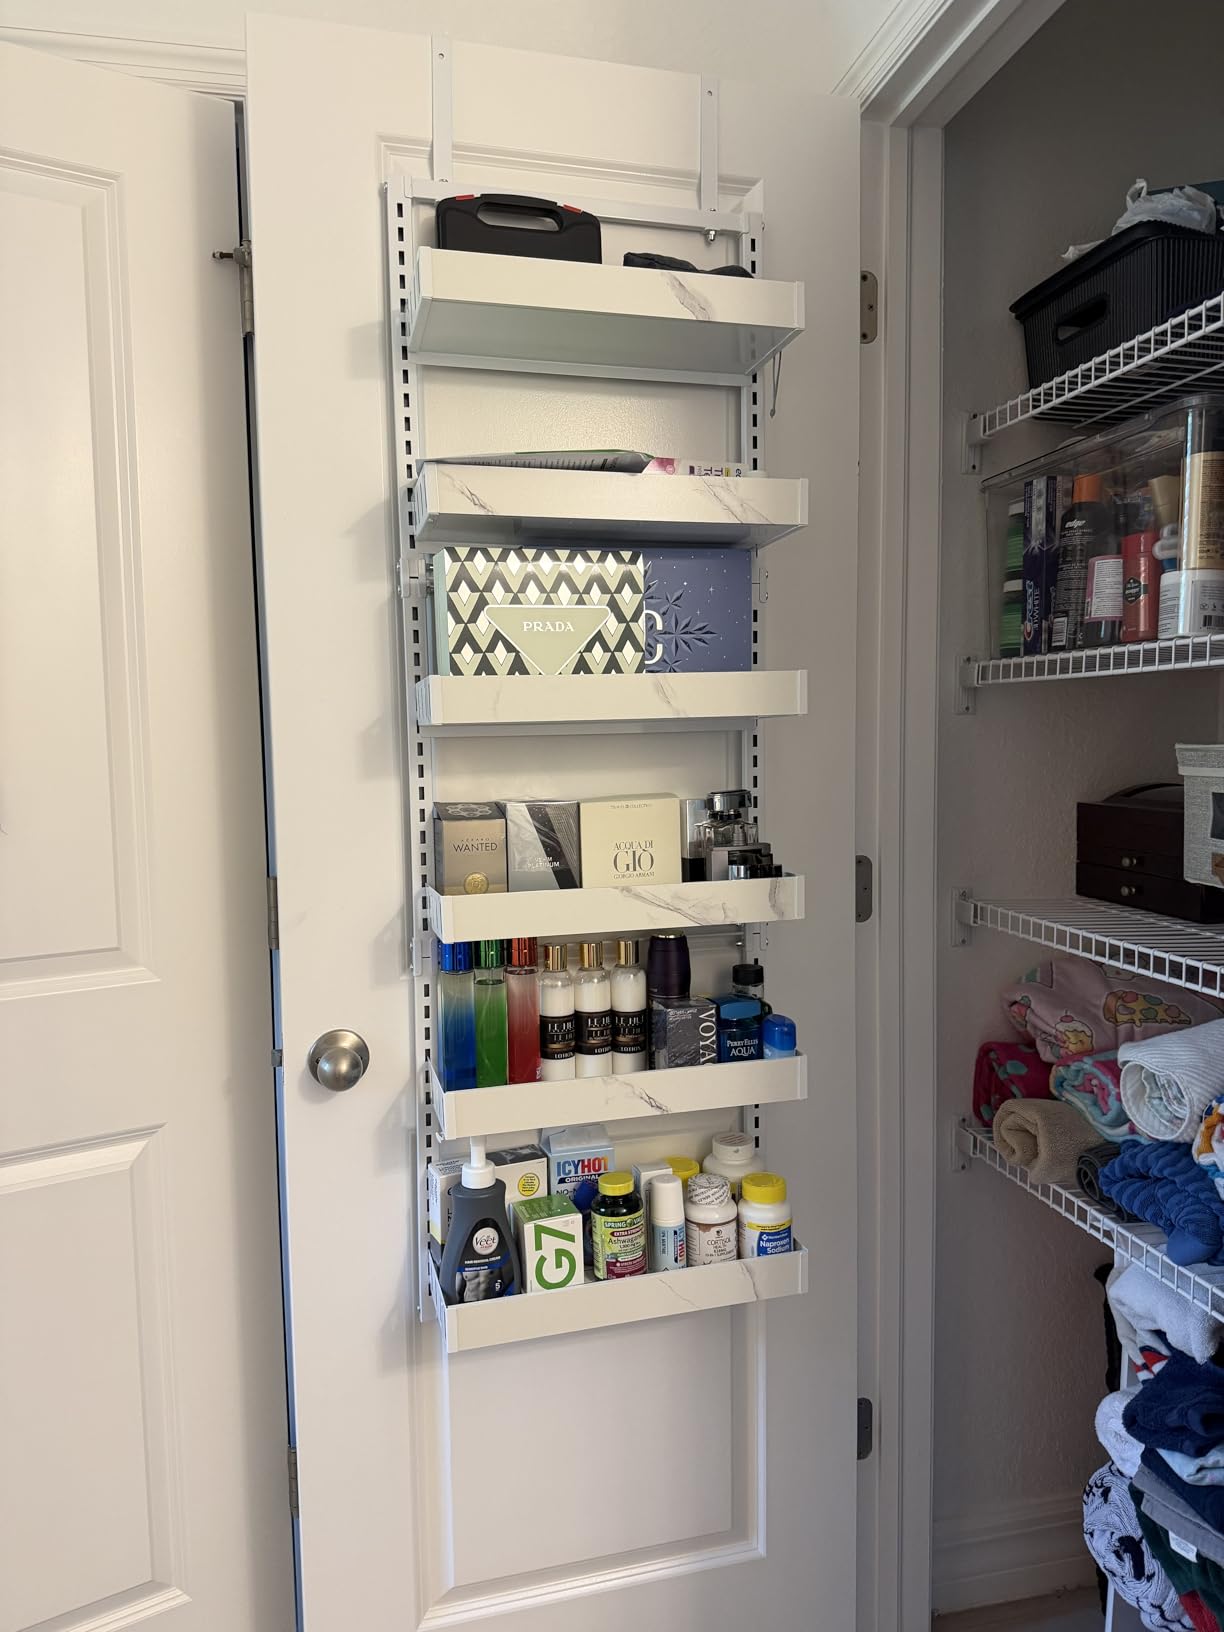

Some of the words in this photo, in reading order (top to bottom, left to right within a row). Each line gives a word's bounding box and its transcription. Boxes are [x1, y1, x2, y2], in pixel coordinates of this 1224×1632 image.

[523, 621, 575, 632] PRADA
[453, 842, 498, 852] WANTED
[614, 840, 642, 850] ACQUA
[644, 840, 654, 849] DI
[613, 848, 654, 873] GIÒ
[699, 1008, 717, 1064] VOYA
[730, 1046, 755, 1057] AQUA
[475, 1234, 497, 1246] Veet
[707, 1236, 731, 1245] CORTISOL
[760, 1237, 790, 1248] Naproxen
[767, 1244, 790, 1254] Sodium
[534, 1224, 576, 1290] G7
